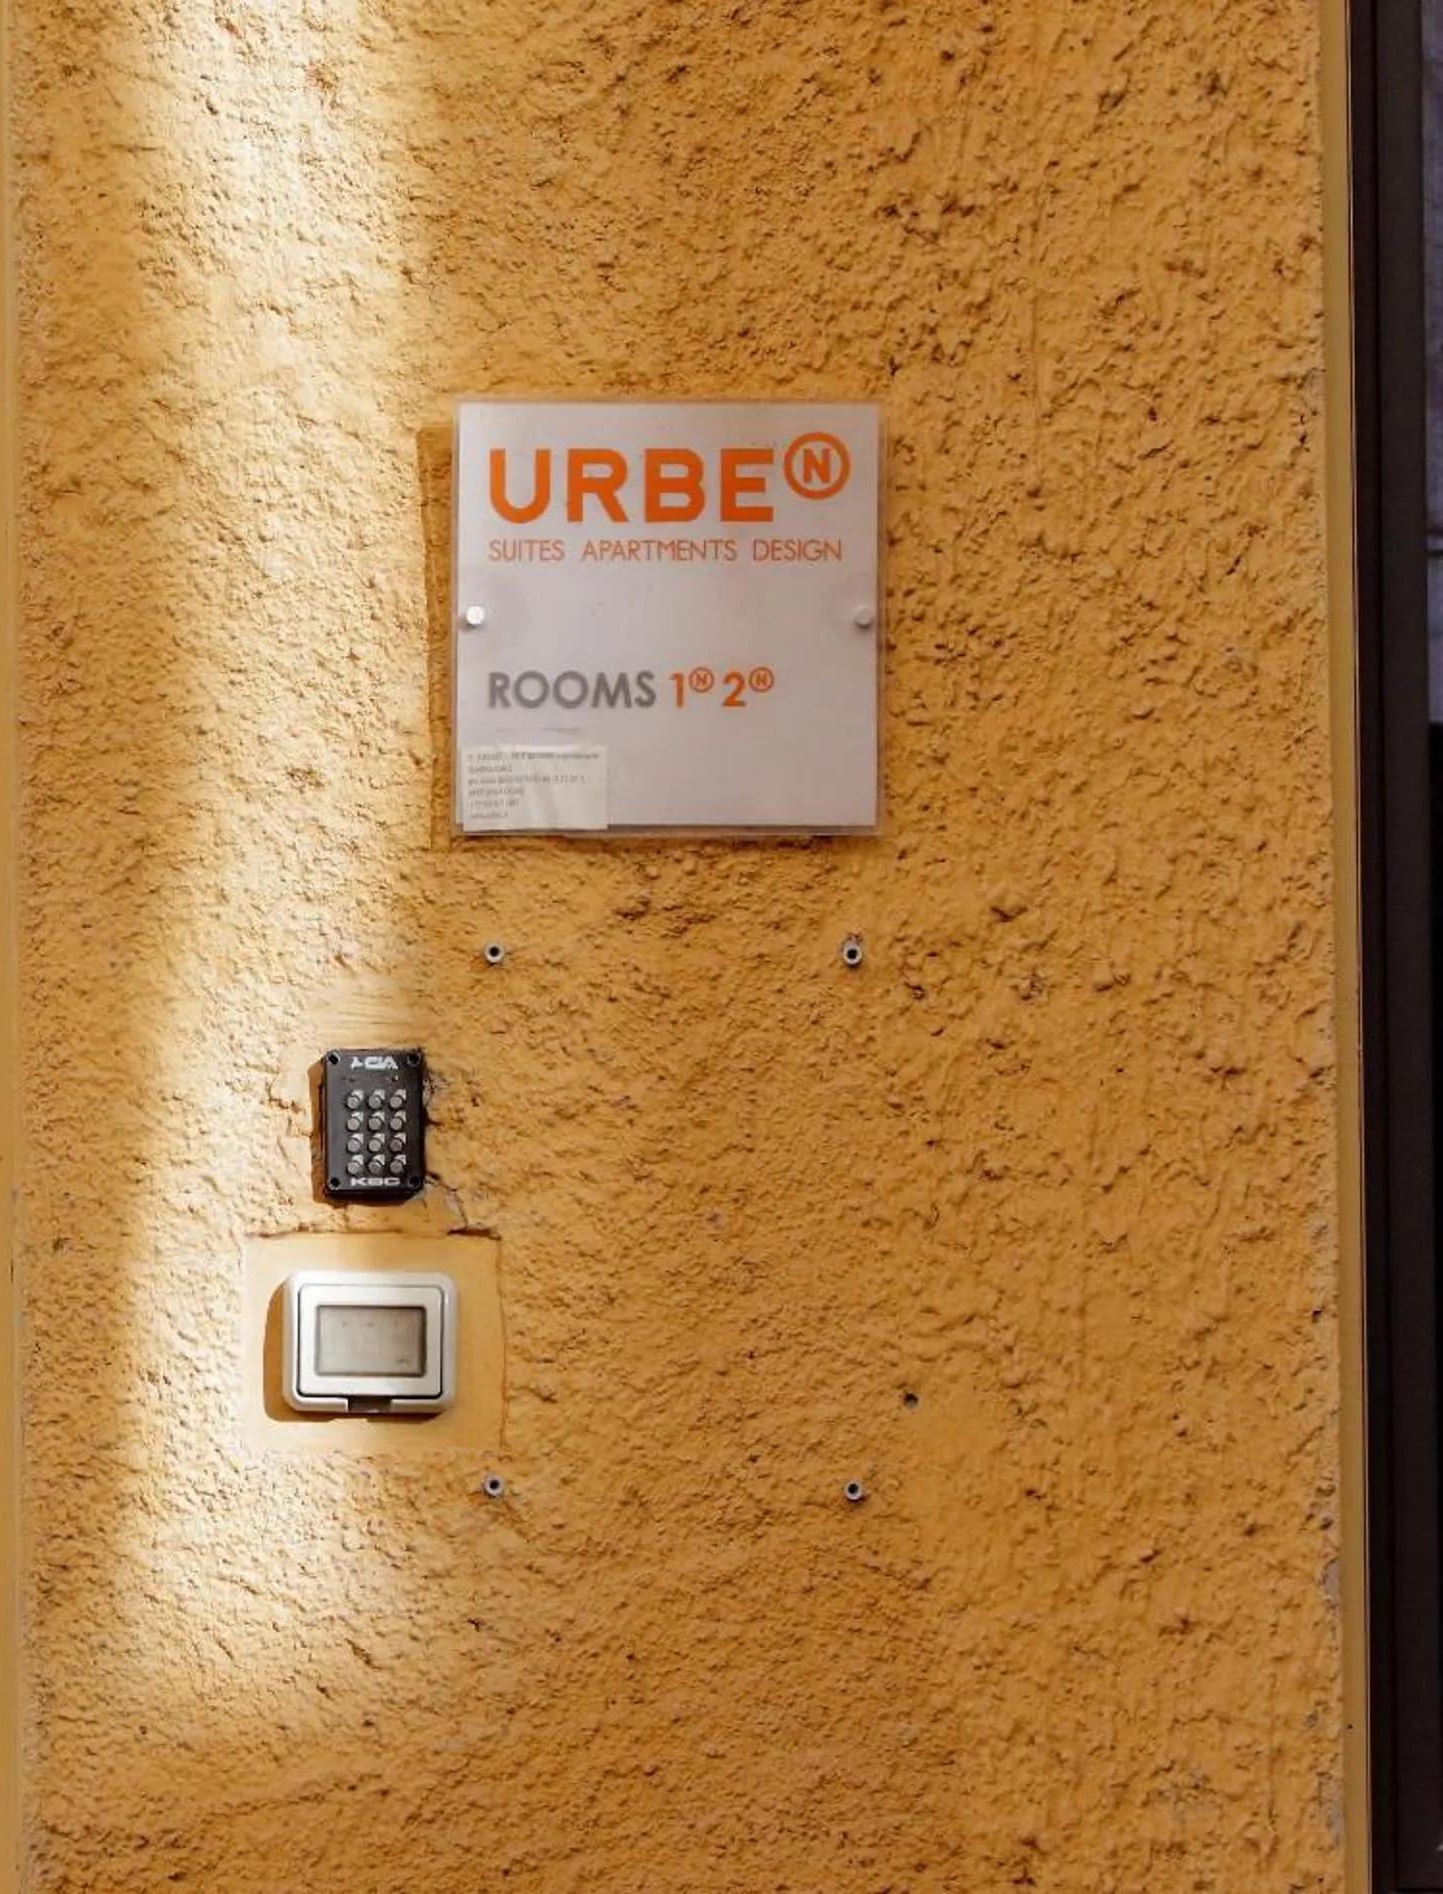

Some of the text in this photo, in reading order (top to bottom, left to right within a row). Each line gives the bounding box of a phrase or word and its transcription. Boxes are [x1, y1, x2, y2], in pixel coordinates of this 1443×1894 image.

[488, 538, 843, 563] SUITES APARTMENTS DESIGN
[487, 669, 657, 710] ROOMS
